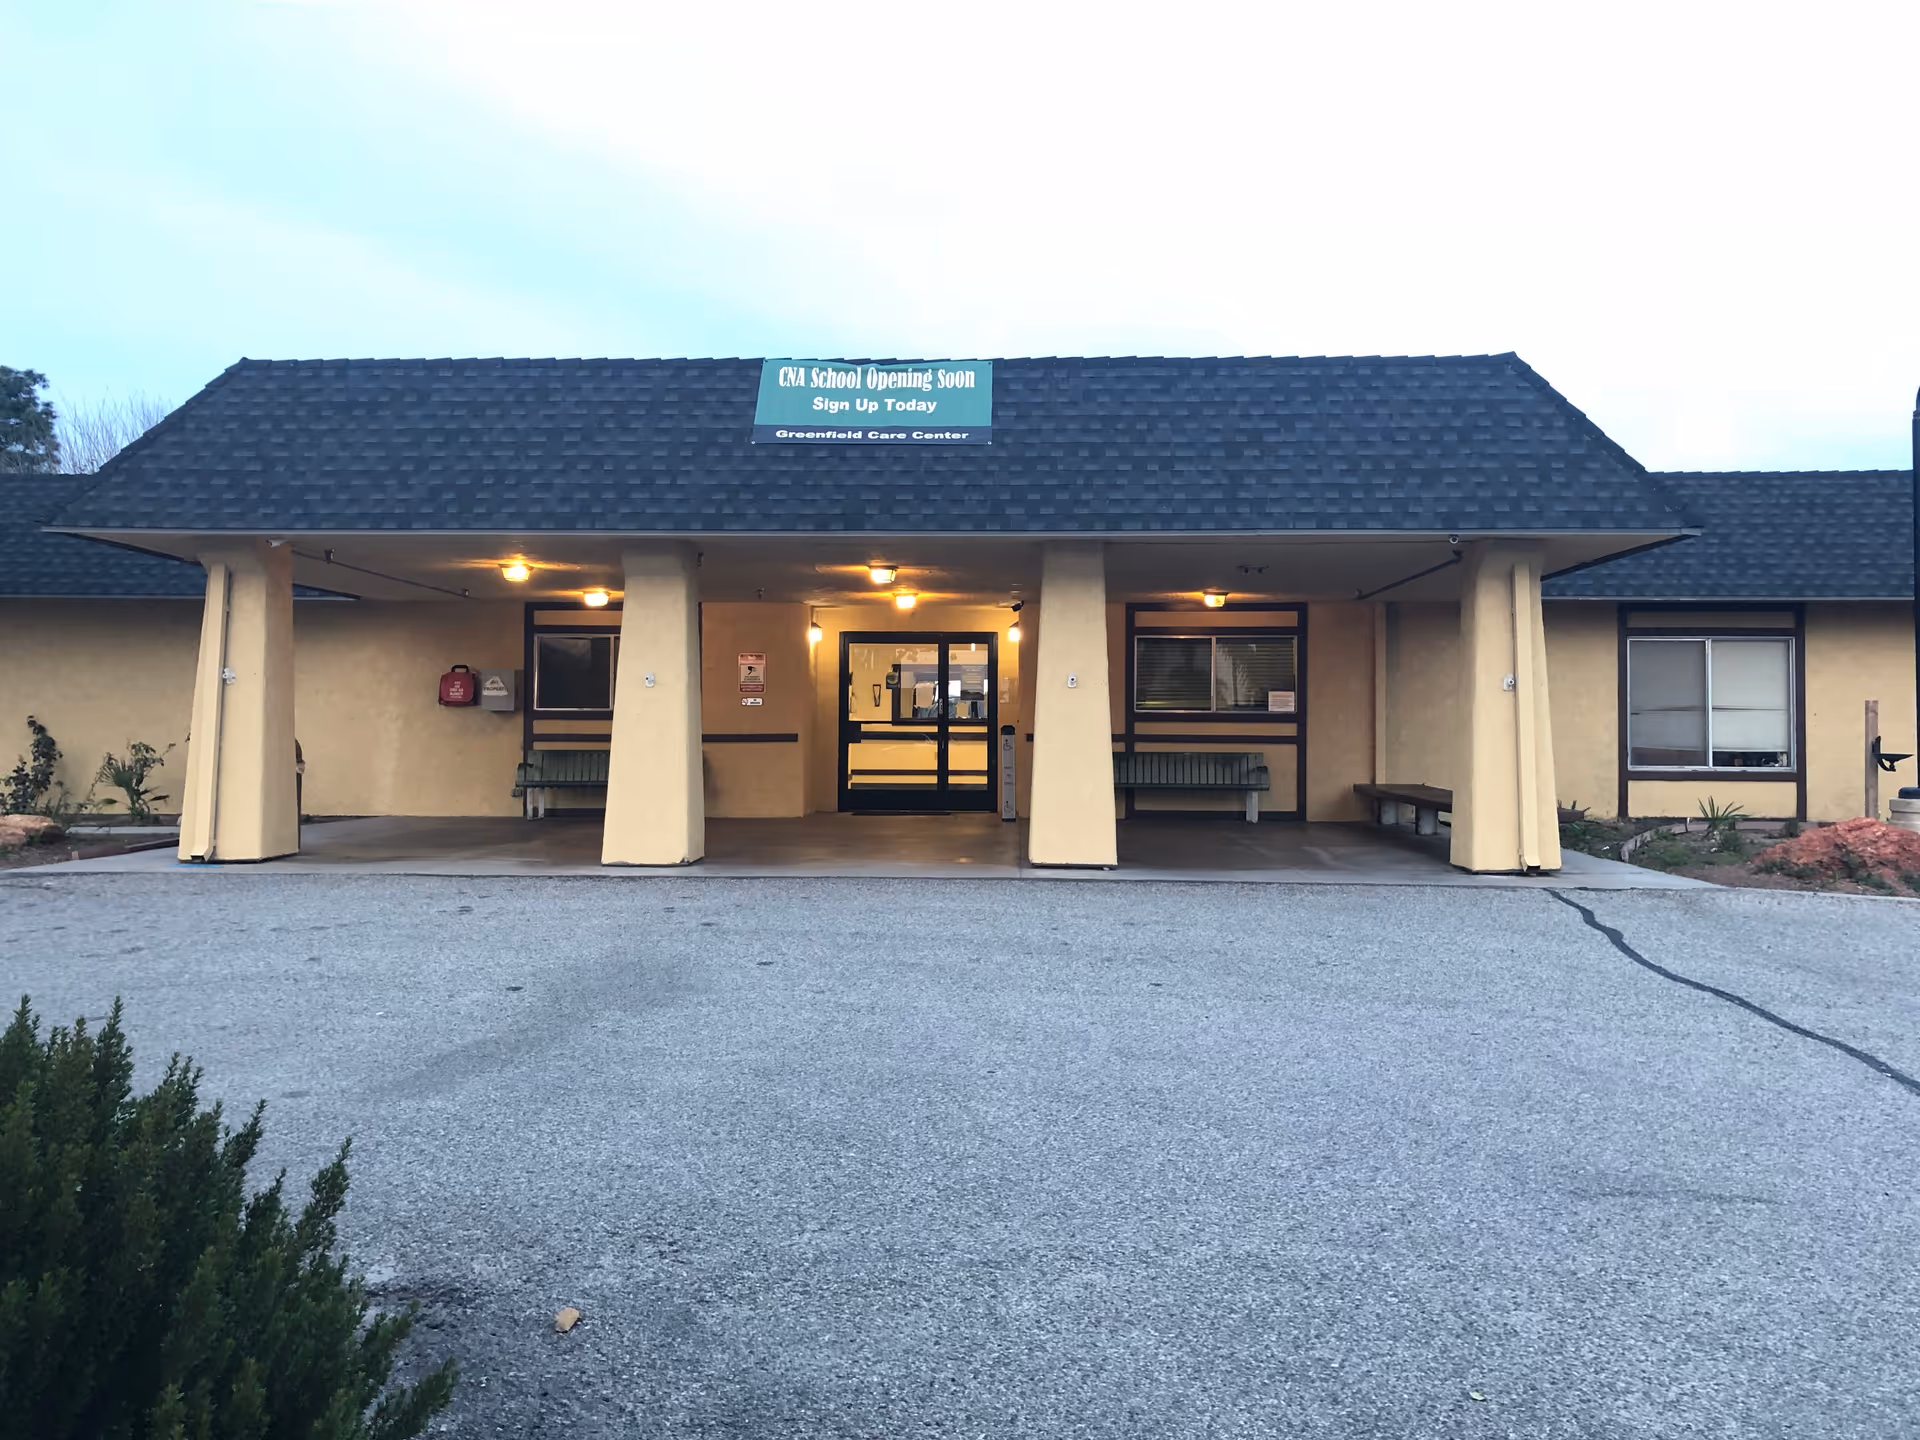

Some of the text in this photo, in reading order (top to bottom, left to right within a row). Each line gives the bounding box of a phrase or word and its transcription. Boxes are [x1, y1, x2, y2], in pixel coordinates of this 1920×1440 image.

[778, 366, 975, 391] CNA School Opening Soon
[812, 396, 937, 413] Sign Up Today
[775, 430, 969, 439] Greenfield Care Center
